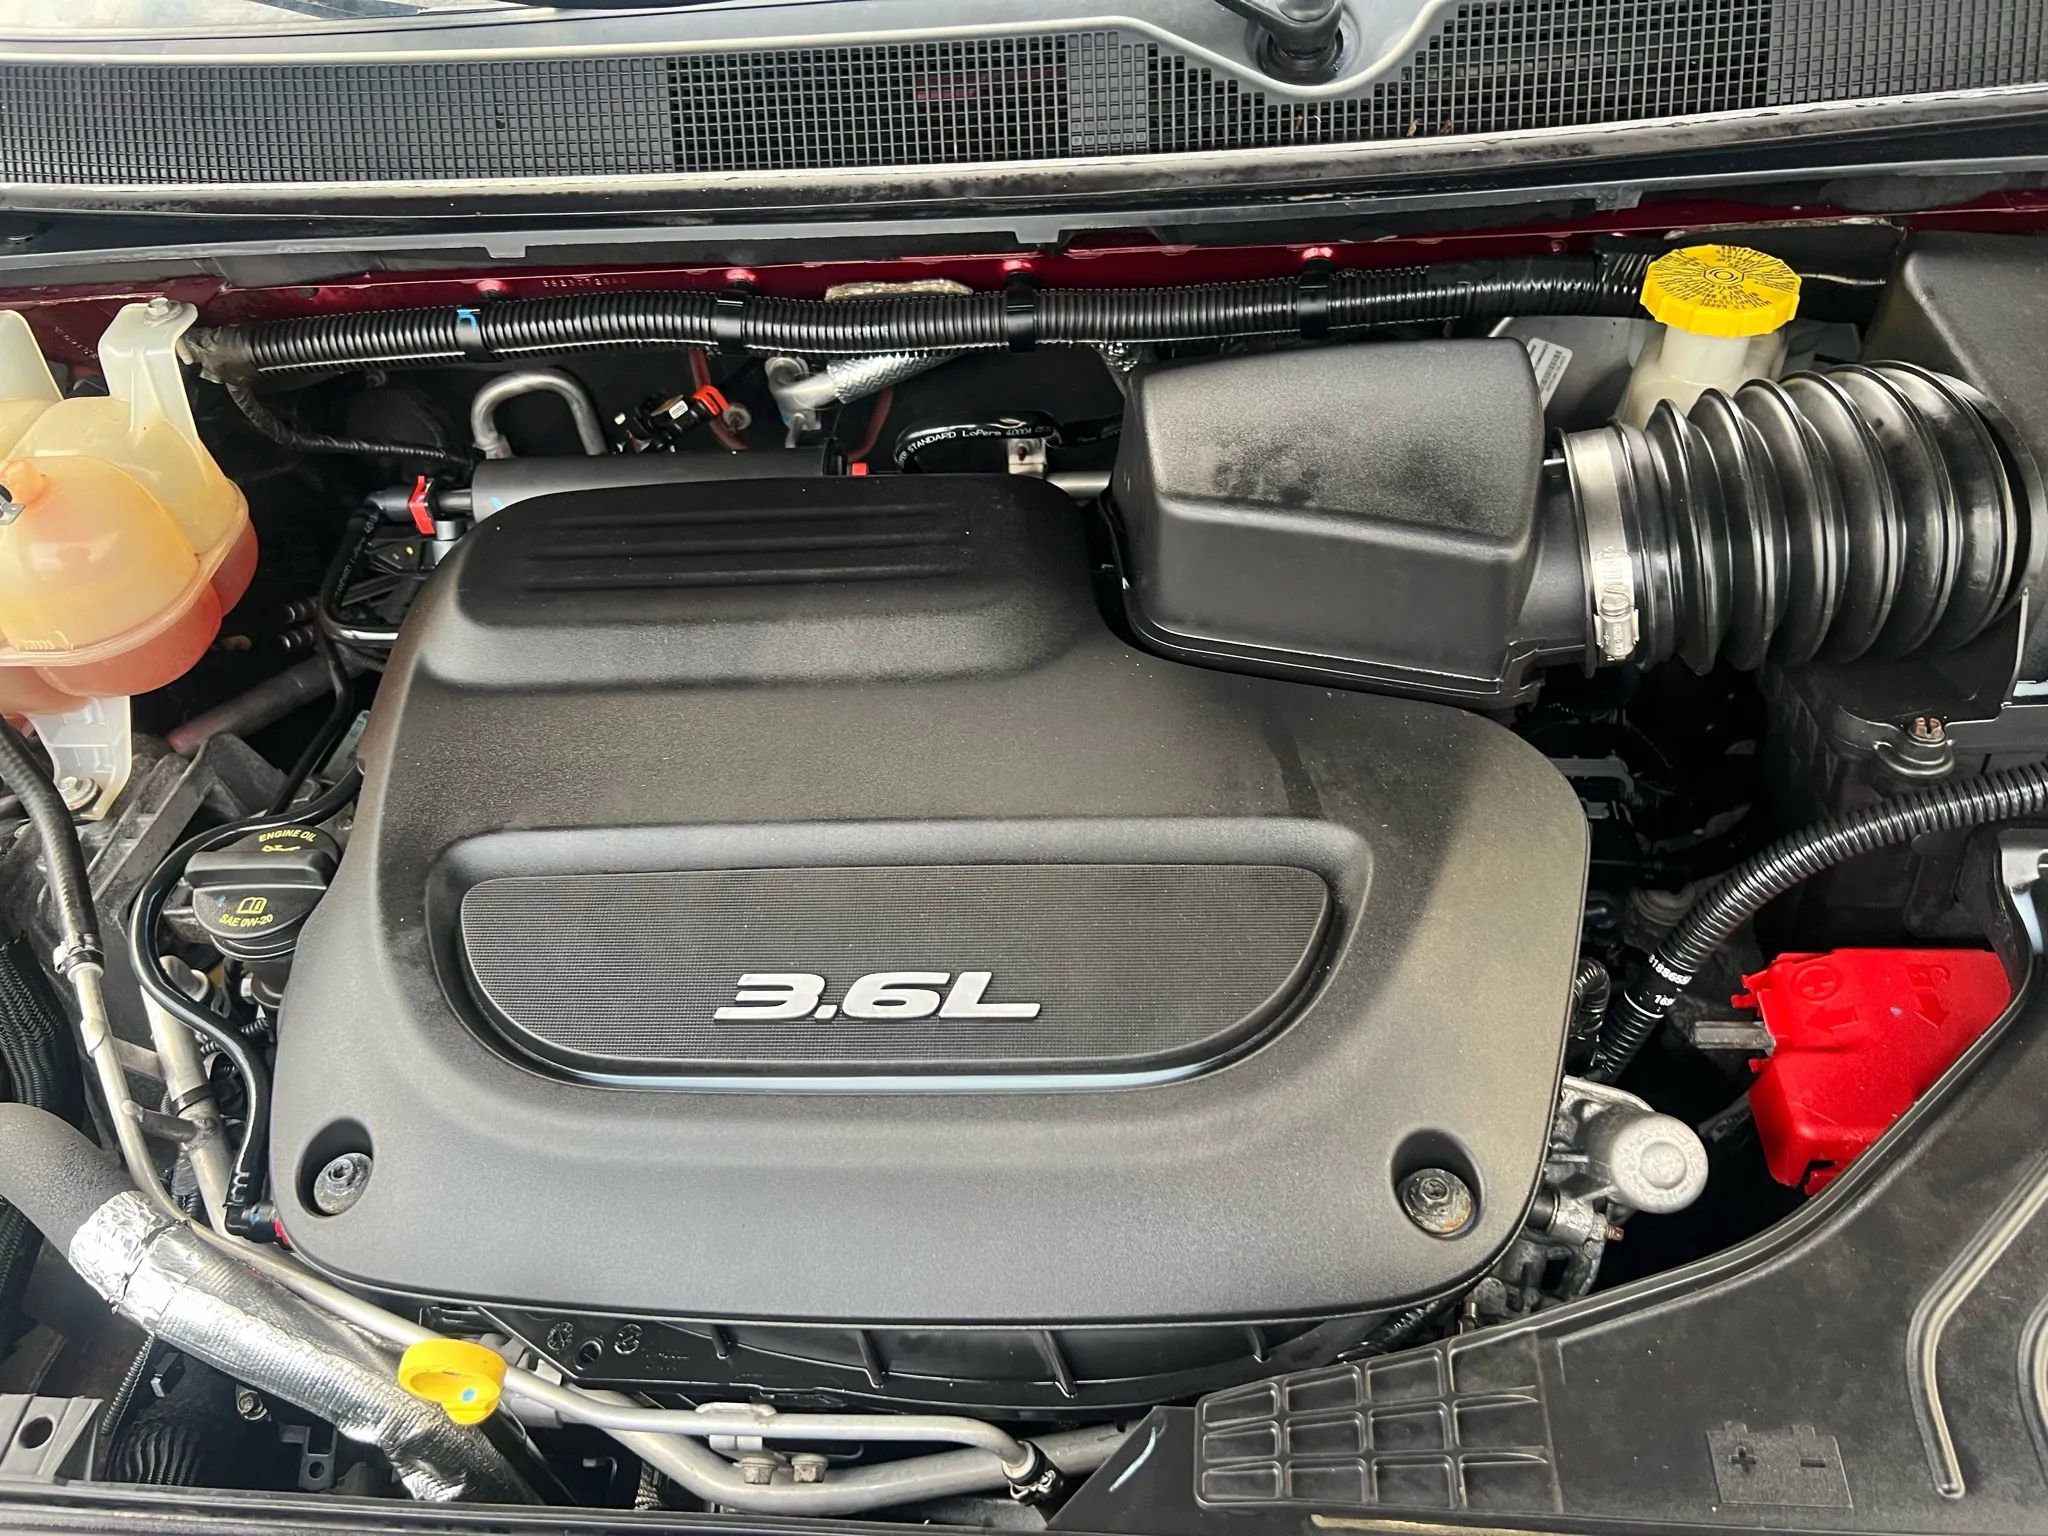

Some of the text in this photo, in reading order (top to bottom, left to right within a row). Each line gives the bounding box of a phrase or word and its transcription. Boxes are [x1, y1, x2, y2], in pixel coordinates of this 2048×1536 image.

[907, 431, 957, 453] STANDARD
[258, 829, 317, 843] ENGINE OIL
[218, 913, 274, 928] SAE 0W-20
[713, 971, 1042, 1019] 3.6L
